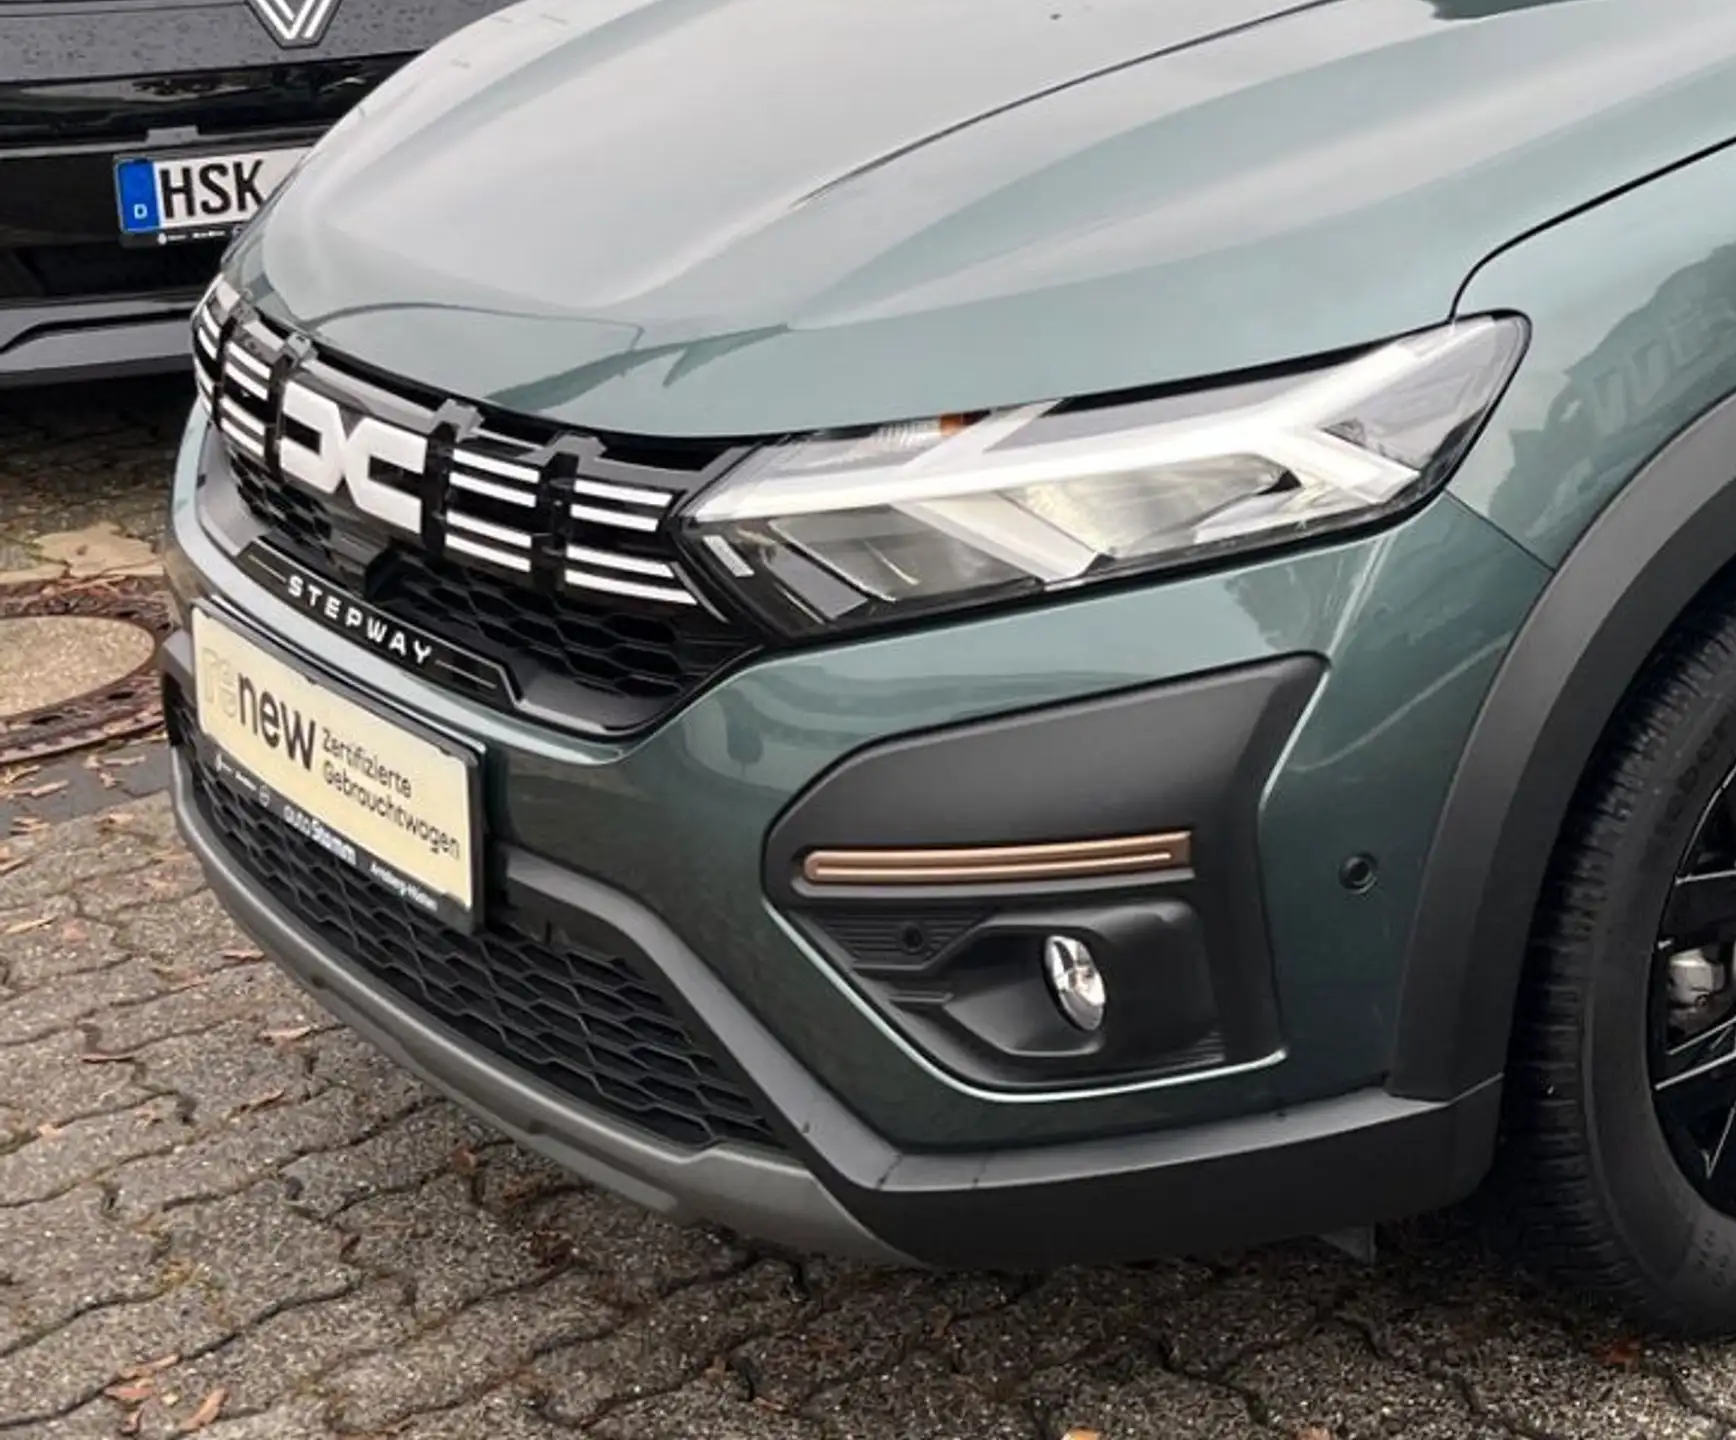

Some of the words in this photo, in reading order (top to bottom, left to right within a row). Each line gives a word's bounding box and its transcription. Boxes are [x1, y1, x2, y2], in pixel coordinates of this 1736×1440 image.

[158, 160, 266, 219] HSK
[288, 574, 432, 664] STEPWAY
[322, 726, 412, 799] Zertifizierte
[323, 759, 461, 861] Gebrauchtwagen
